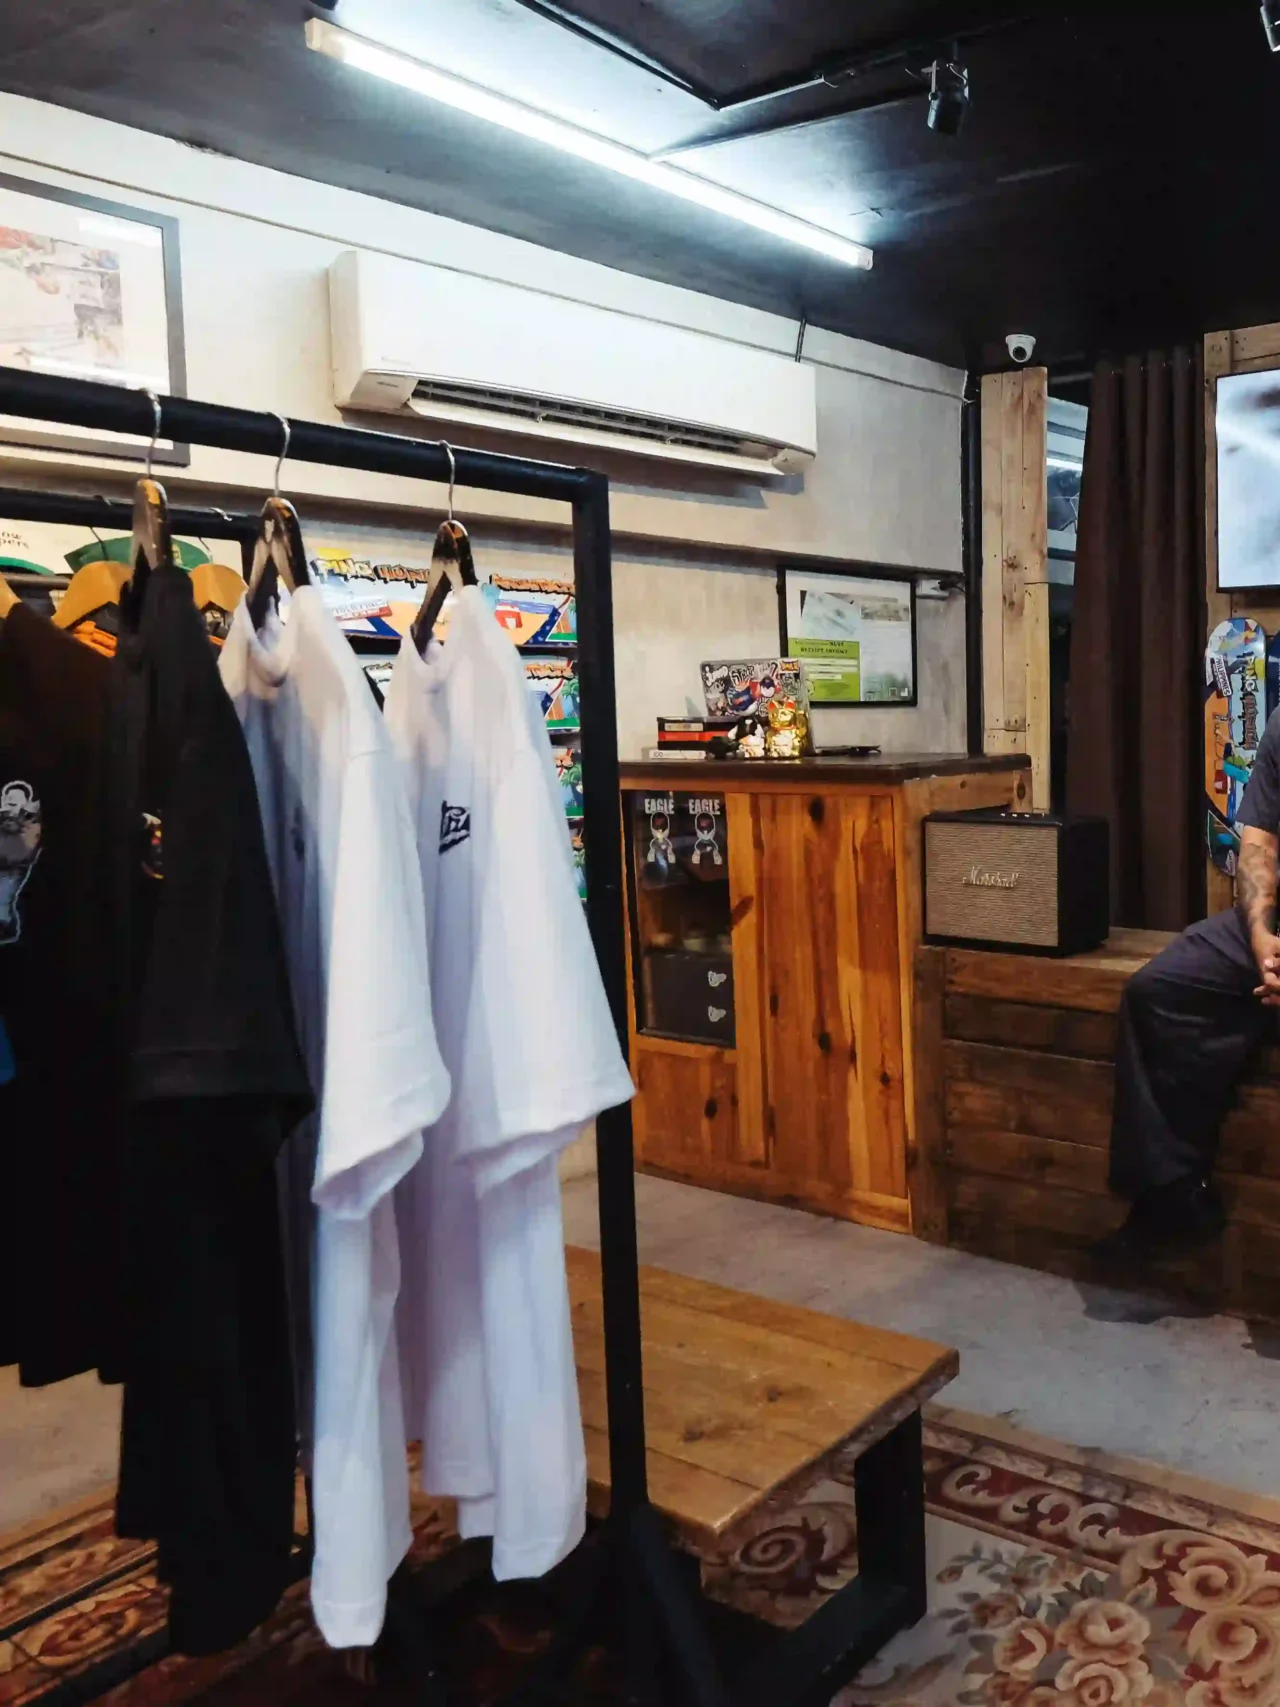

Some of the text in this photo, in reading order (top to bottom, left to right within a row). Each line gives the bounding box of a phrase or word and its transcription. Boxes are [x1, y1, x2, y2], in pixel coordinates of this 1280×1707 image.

[644, 798, 675, 814] EAGLE
[688, 798, 721, 815] EAGLE
[962, 865, 1019, 888] Marshall
